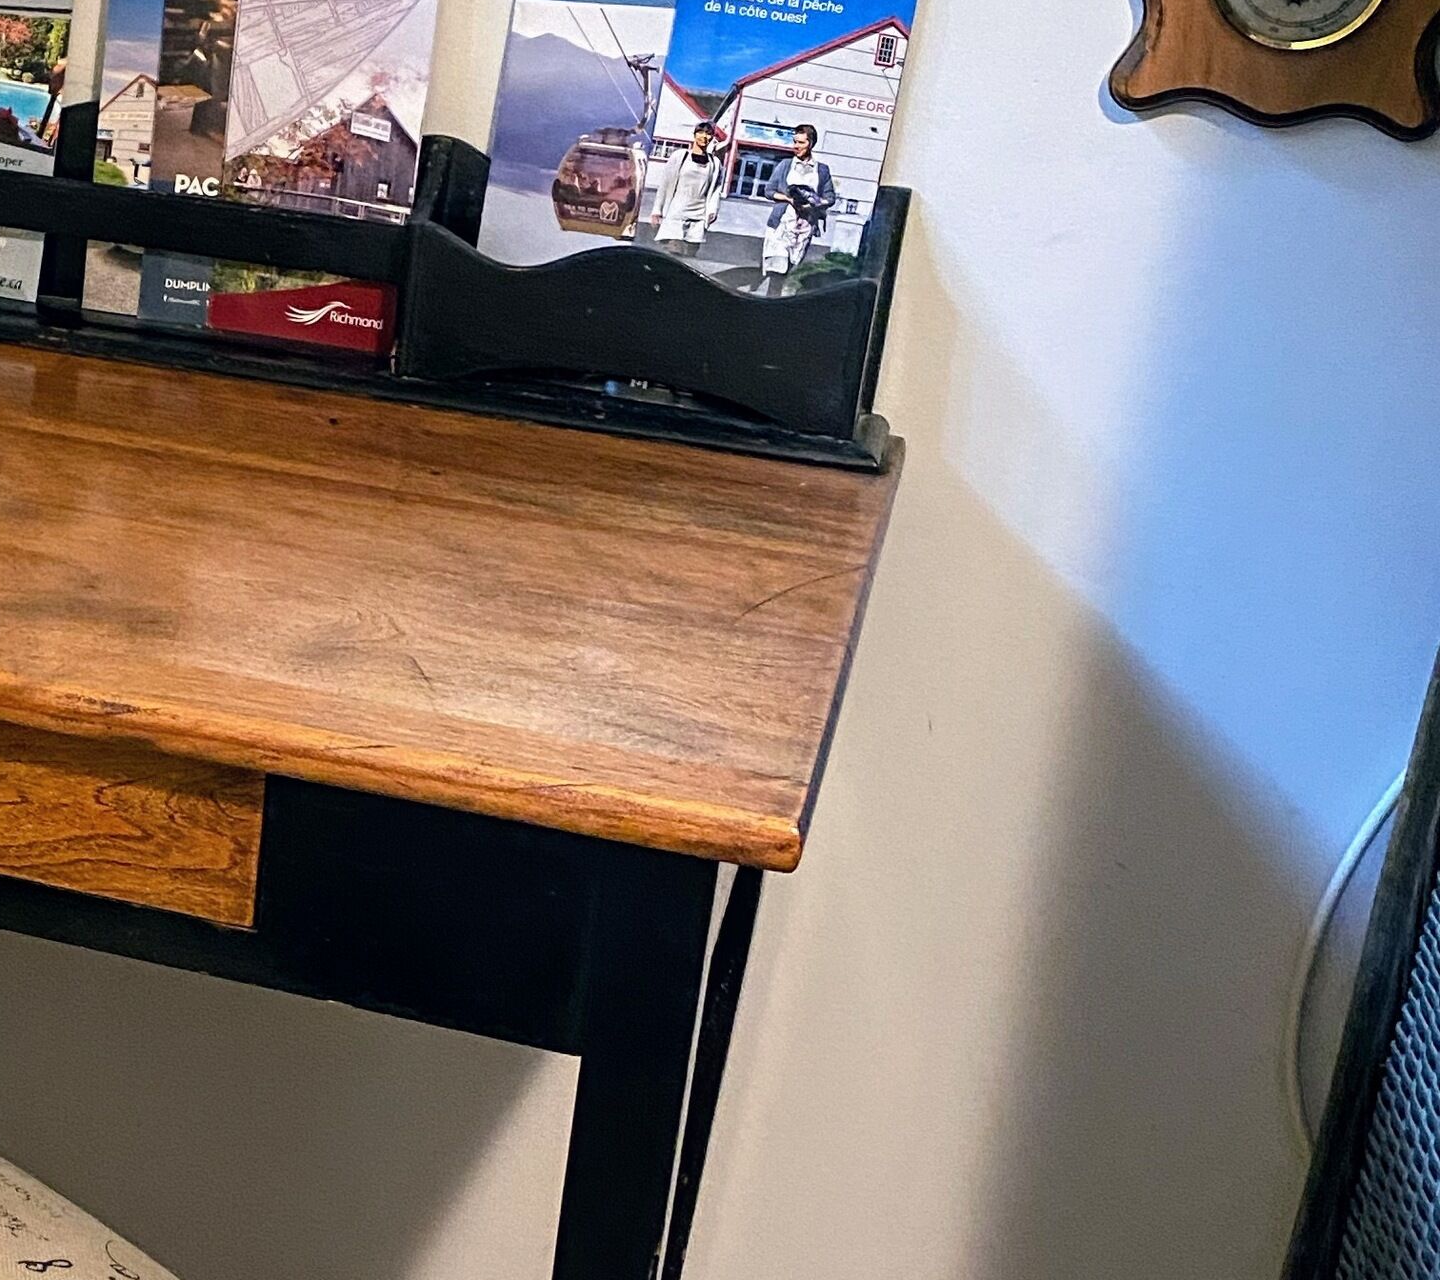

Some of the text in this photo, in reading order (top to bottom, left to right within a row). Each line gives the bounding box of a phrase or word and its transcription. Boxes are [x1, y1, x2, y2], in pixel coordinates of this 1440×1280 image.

[704, 0, 808, 25] de la côte ouest
[785, 88, 896, 115] GULF OF GEORG
[174, 174, 220, 196] PAC
[329, 310, 384, 330] Richmond
